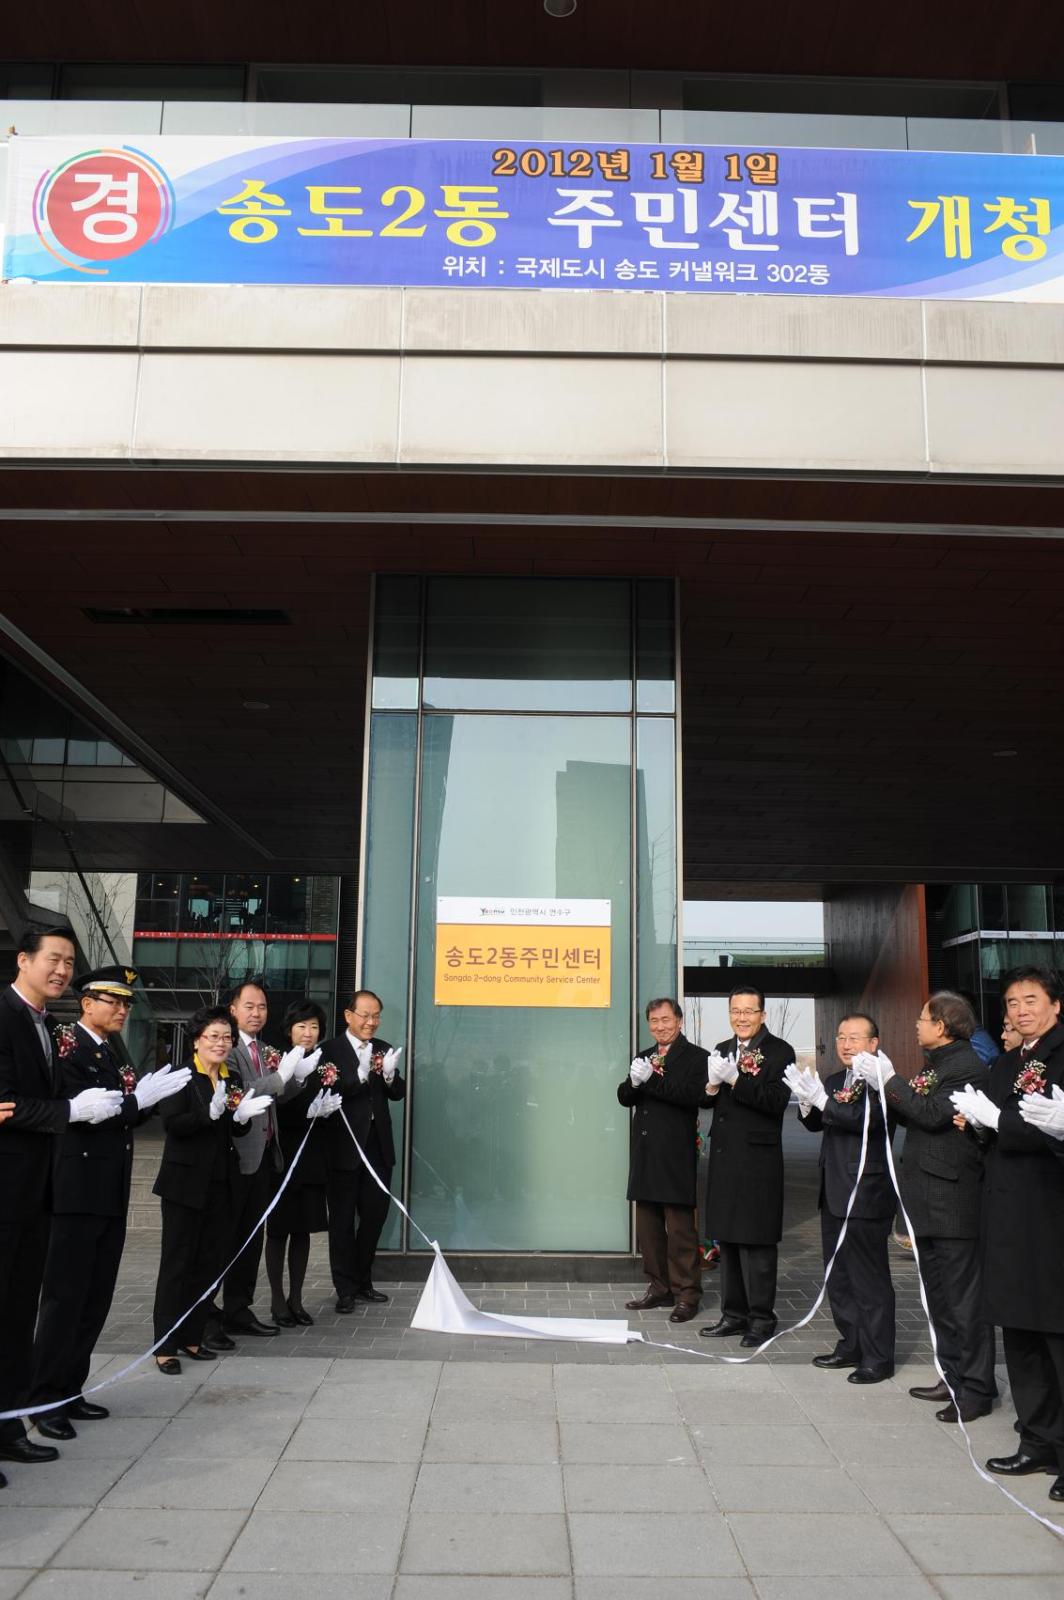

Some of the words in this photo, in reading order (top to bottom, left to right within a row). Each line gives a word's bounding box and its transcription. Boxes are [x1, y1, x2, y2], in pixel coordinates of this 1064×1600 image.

[491, 148, 630, 182] 2012년
[650, 151, 706, 183] 1월
[724, 153, 779, 186] 1일
[71, 171, 140, 245] 경
[215, 179, 510, 248] 송도2동
[547, 187, 860, 256] 주민센터
[906, 194, 1052, 262] 개청
[442, 256, 487, 278] 위치
[515, 256, 605, 281] 국제도시
[614, 258, 660, 281] 송도
[668, 259, 759, 283] 커낼워크
[766, 263, 830, 286] 302동
[444, 945, 601, 970] 송도2동주민센터
[443, 973, 472, 984] Songdo
[474, 973, 502, 984] 2-dong
[503, 974, 544, 985] Community
[546, 975, 574, 984] Service
[575, 975, 601, 985] Center
